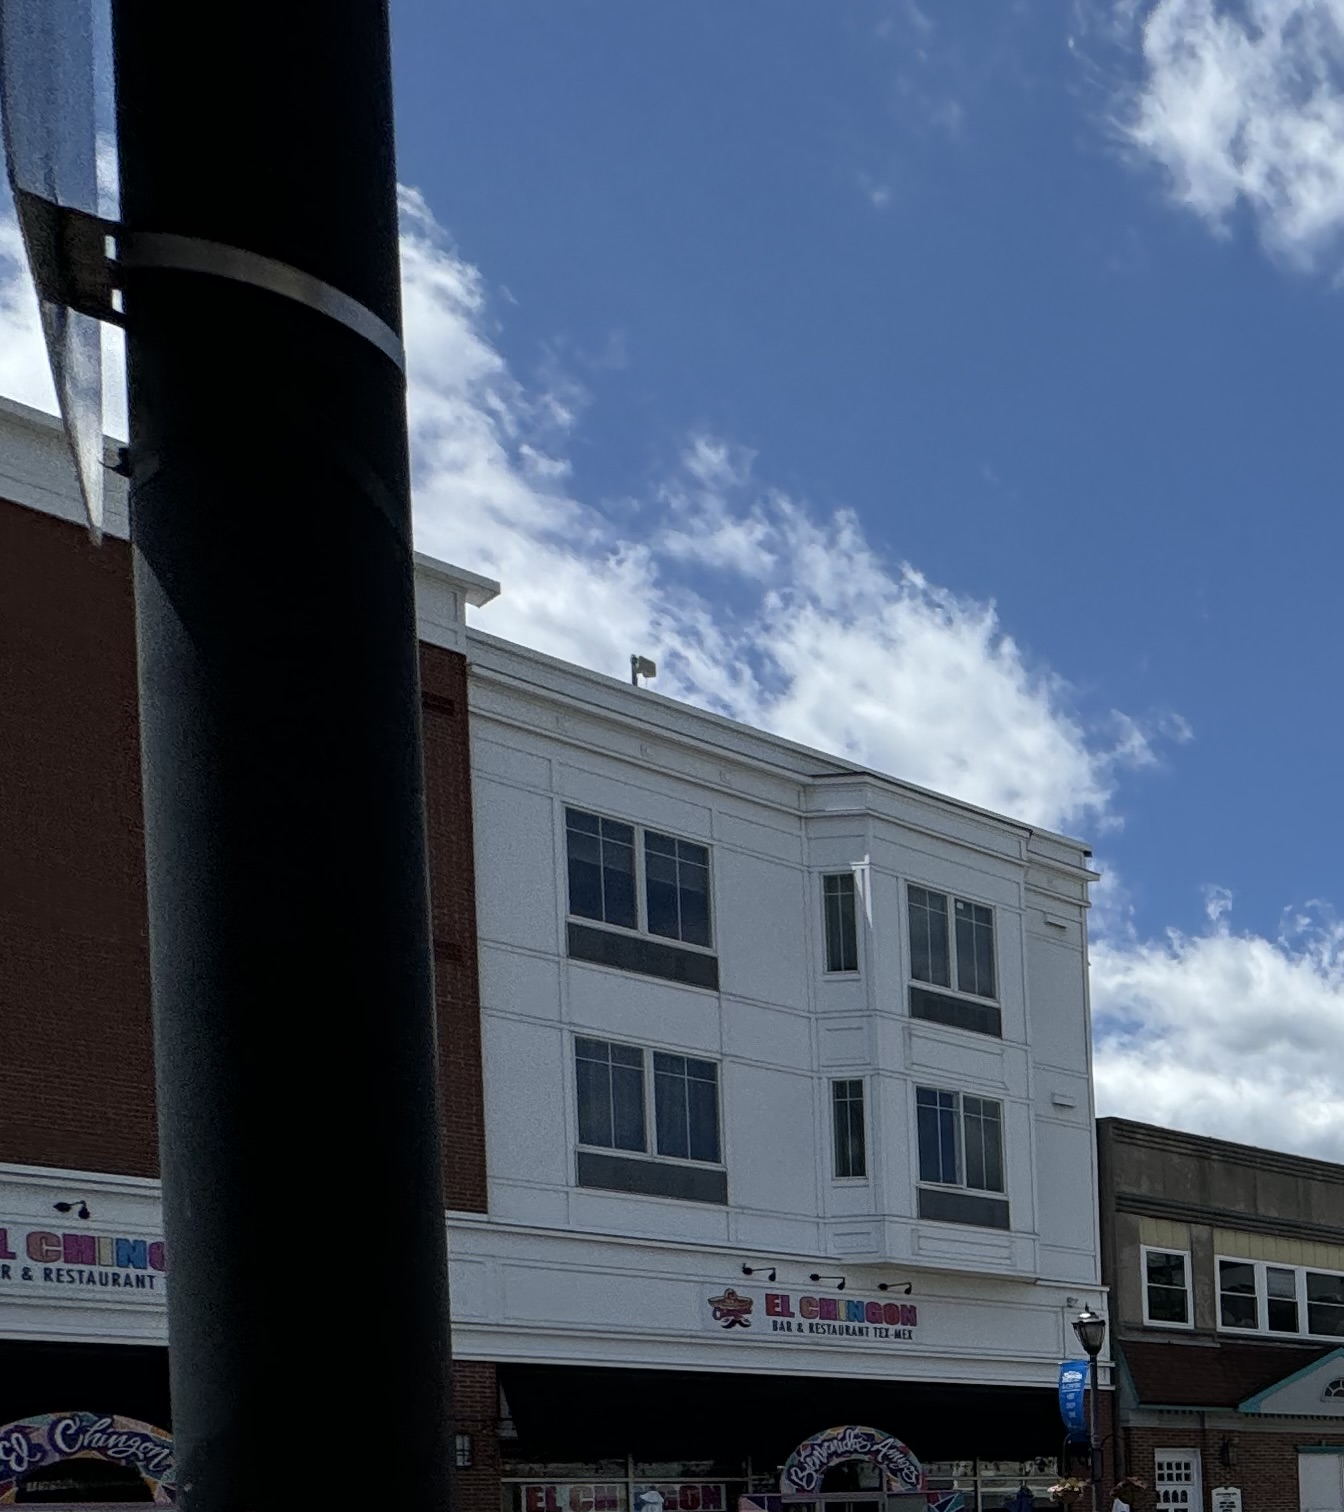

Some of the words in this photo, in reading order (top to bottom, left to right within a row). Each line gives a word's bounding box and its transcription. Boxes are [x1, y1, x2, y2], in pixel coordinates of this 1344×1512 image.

[0, 1228, 17, 1260] L
[43, 1267, 156, 1290] RESTAURANT
[765, 1293, 795, 1318] EL
[800, 1296, 917, 1327] CHINGON
[772, 1319, 793, 1332] BAR
[796, 1322, 804, 1333] &
[809, 1322, 870, 1337] RESTAURANT
[873, 1326, 913, 1340] TEX-MEX
[54, 1417, 170, 1471] Chingon
[526, 1486, 562, 1512] EL
